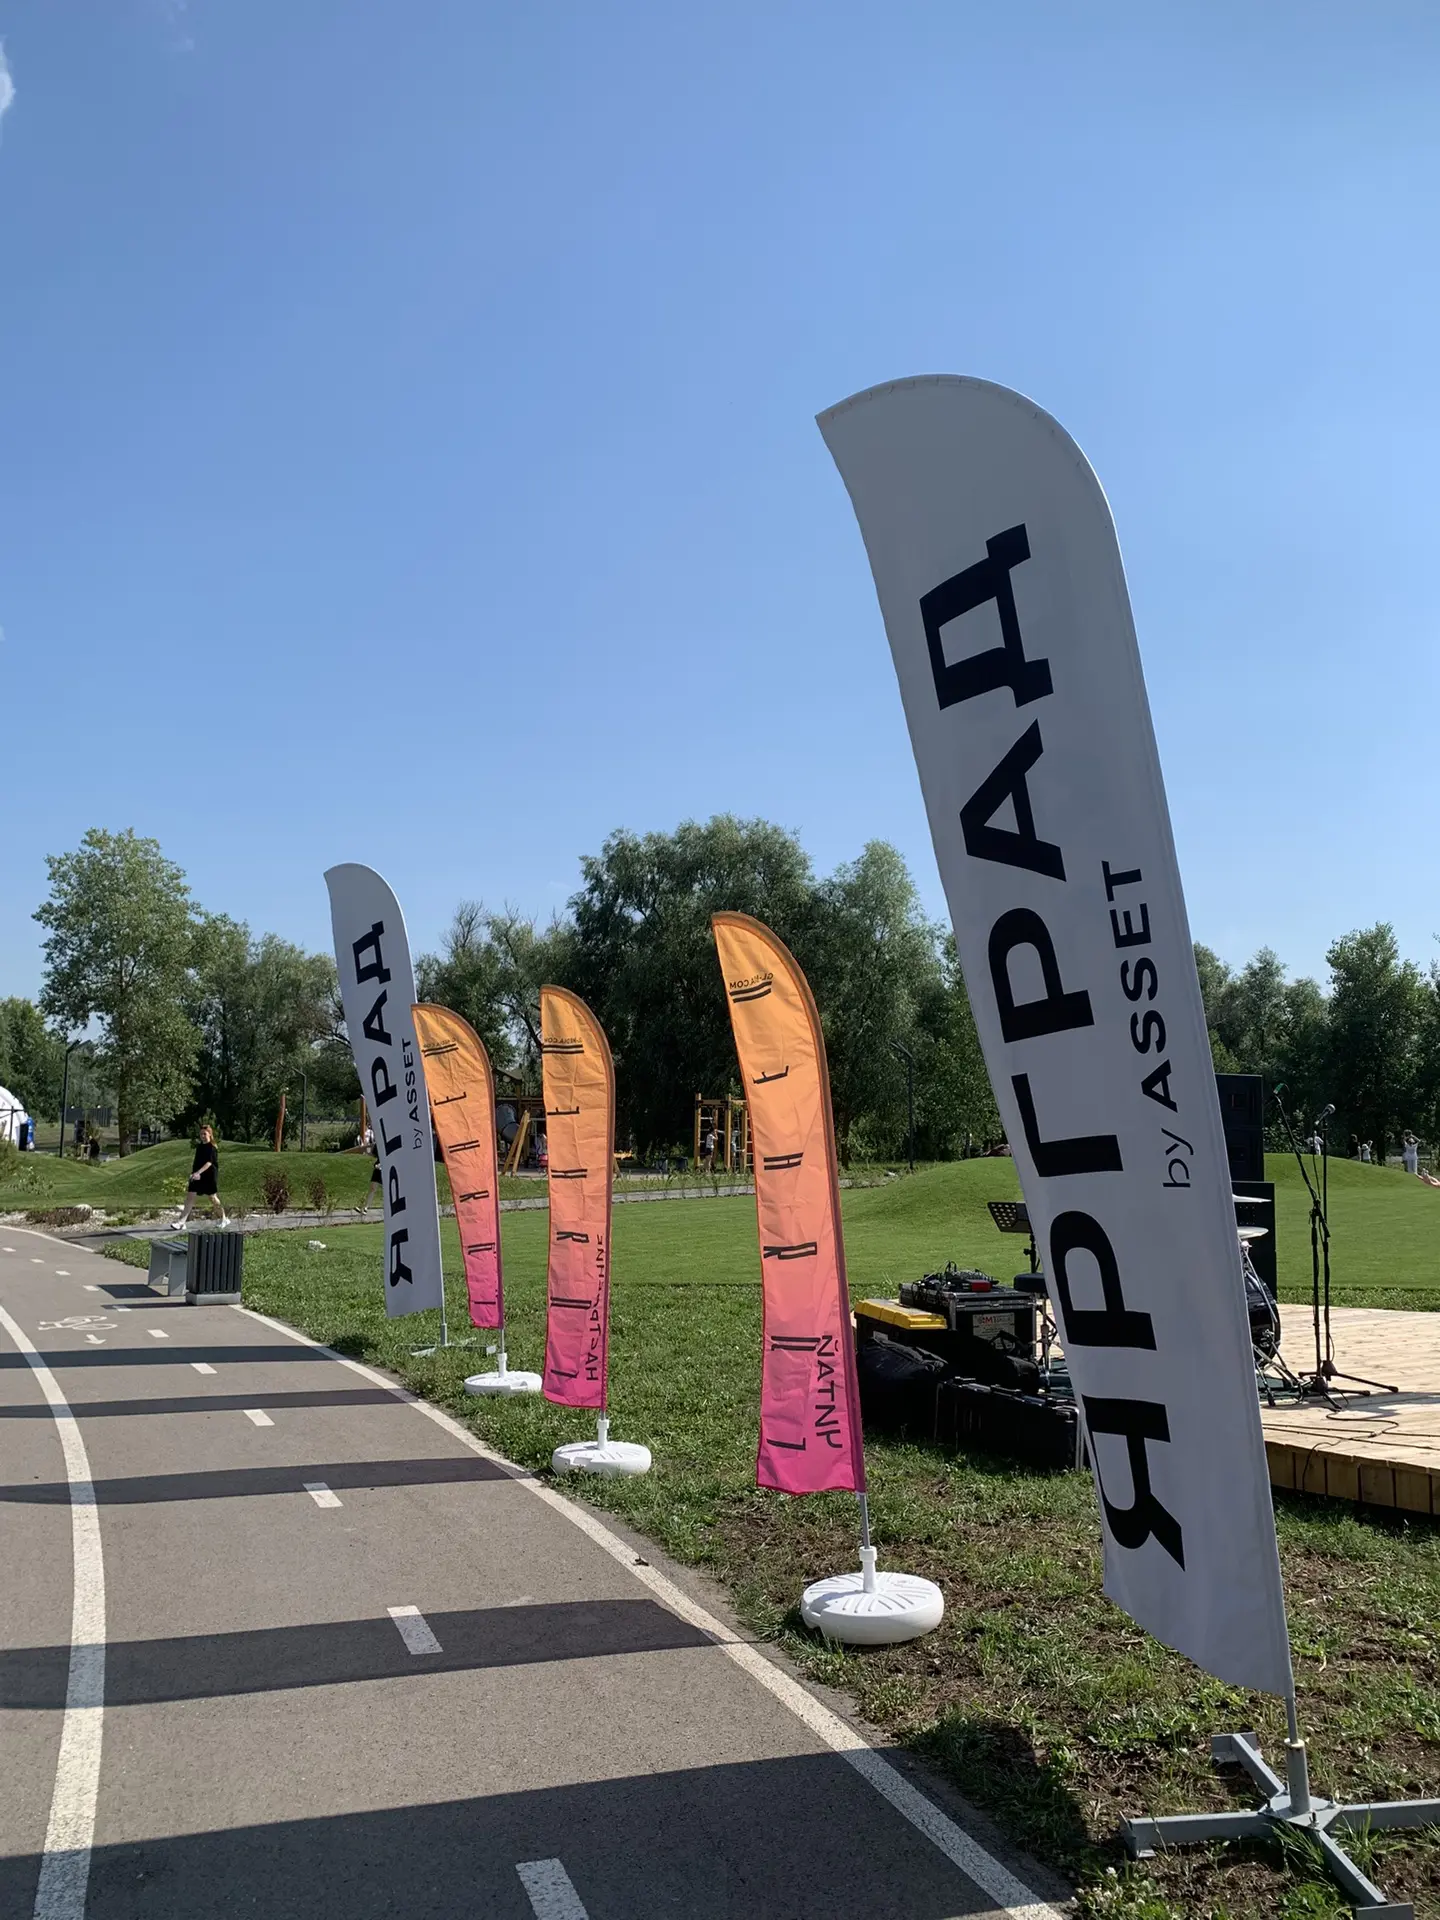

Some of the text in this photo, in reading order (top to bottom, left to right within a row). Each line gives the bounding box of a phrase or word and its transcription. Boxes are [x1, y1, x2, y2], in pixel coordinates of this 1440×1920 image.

[352, 921, 413, 1288] ЯРГРАД
[401, 1038, 425, 1151] by ASSET
[920, 523, 1184, 1569] ЯРГРАД
[1101, 859, 1195, 1190] by ASSET
